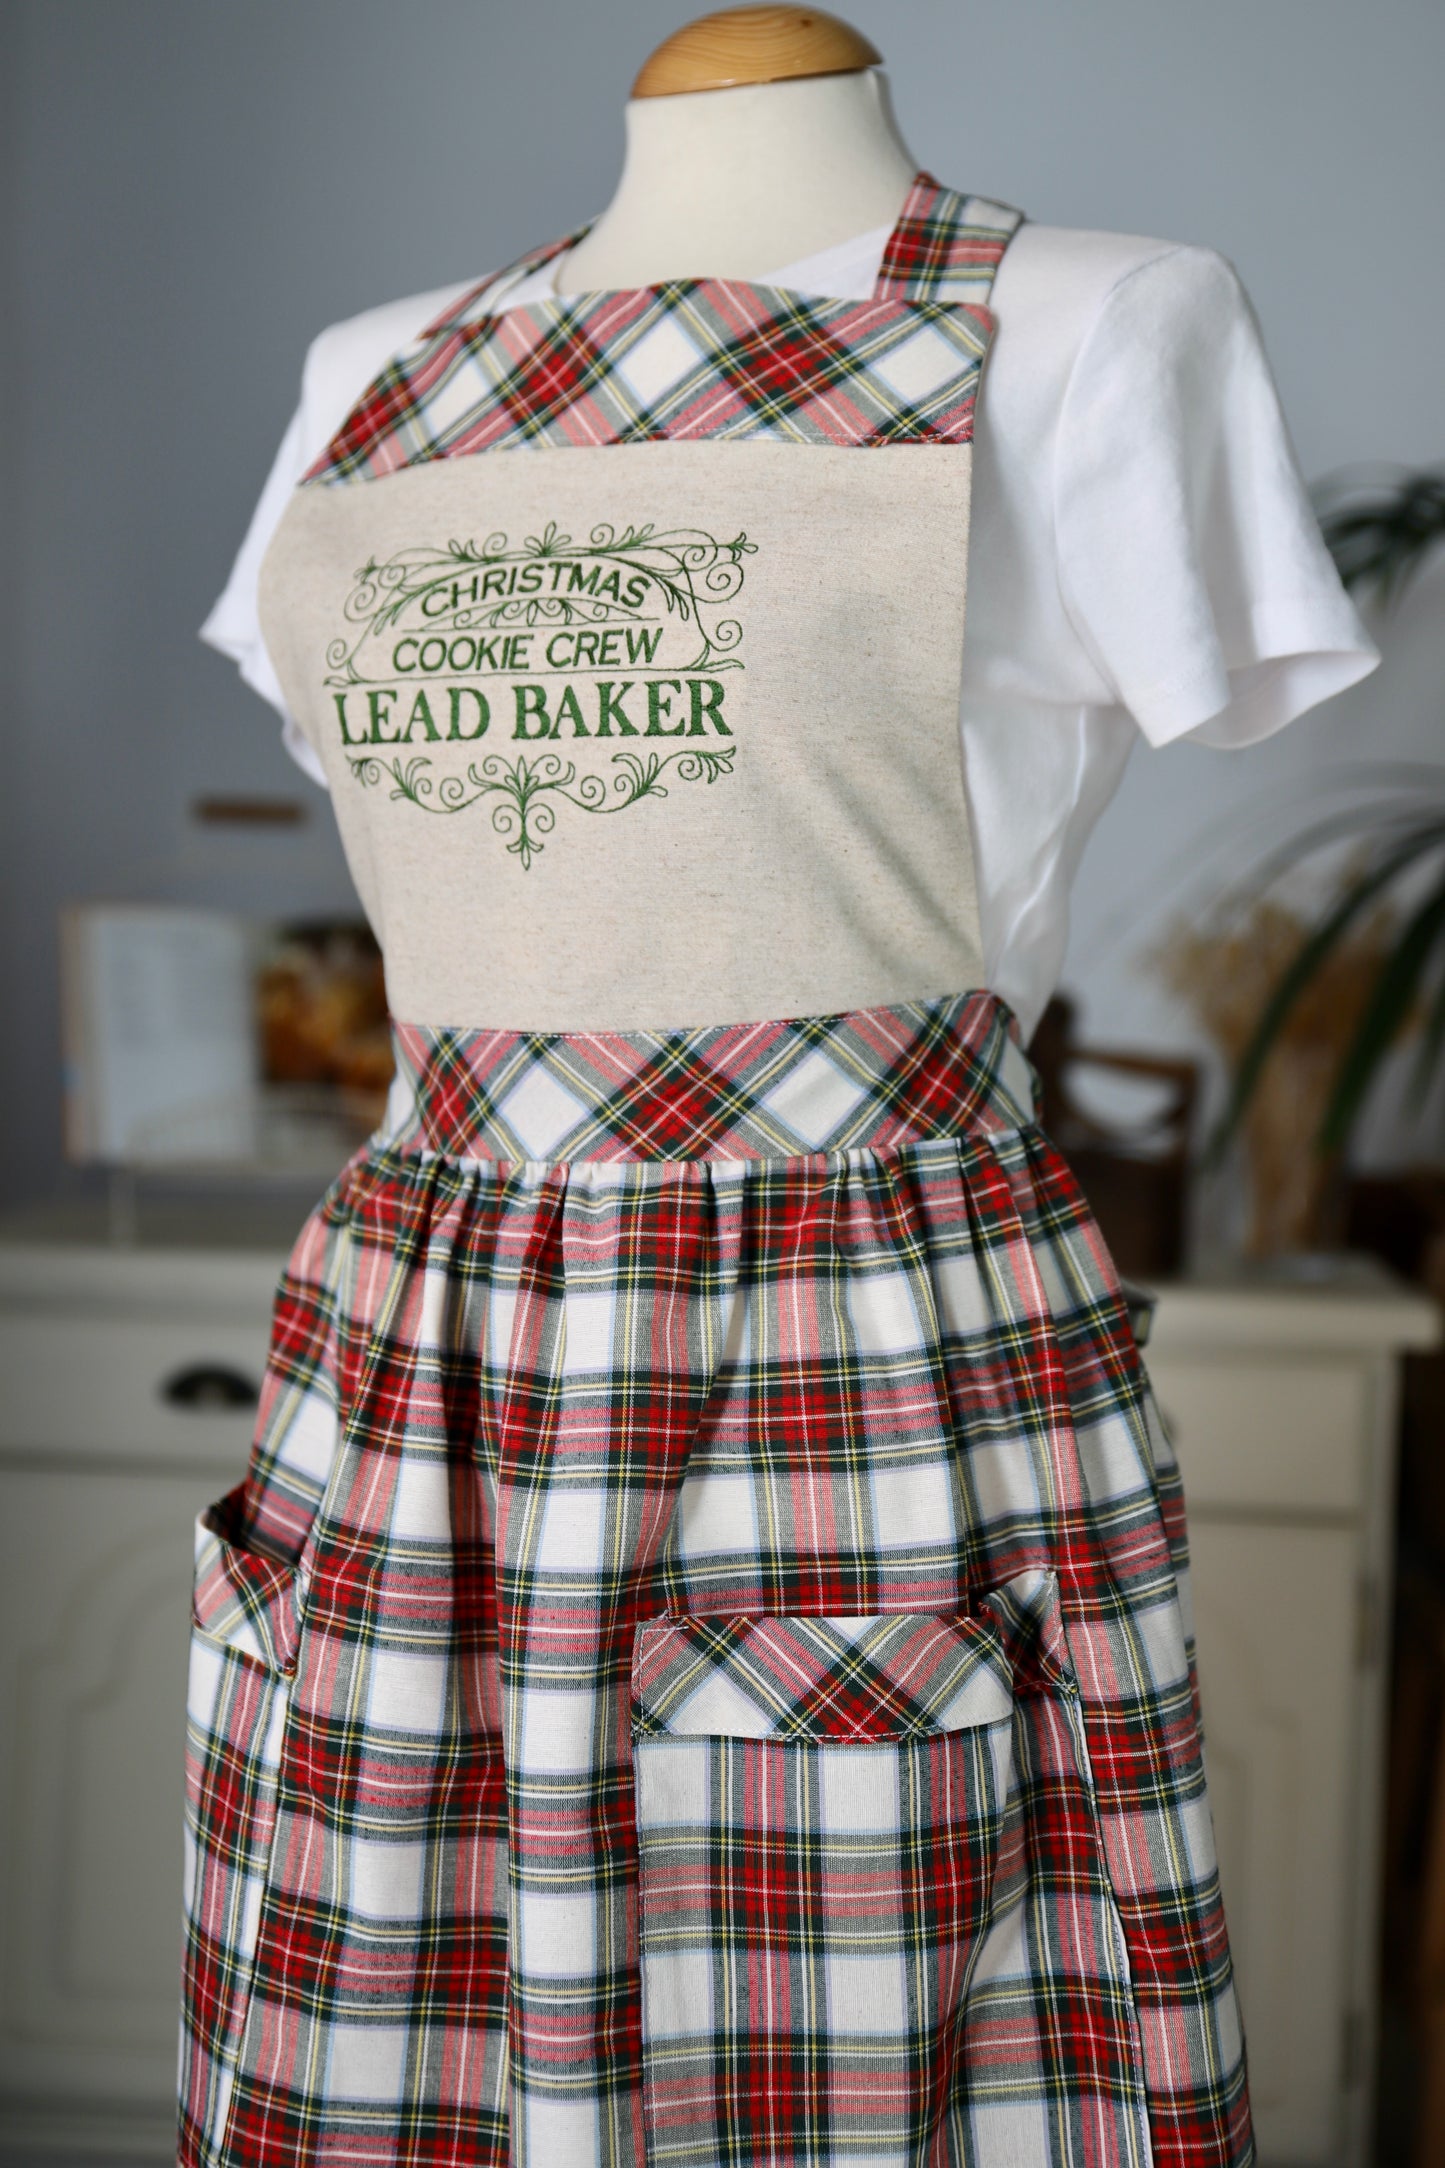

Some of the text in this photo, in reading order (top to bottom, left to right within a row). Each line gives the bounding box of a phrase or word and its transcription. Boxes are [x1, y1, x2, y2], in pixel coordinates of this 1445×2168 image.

[421, 561, 652, 618] CHRISTMAS
[393, 627, 664, 672] COOKIE CREW
[333, 678, 734, 746] LEAD BAKER
